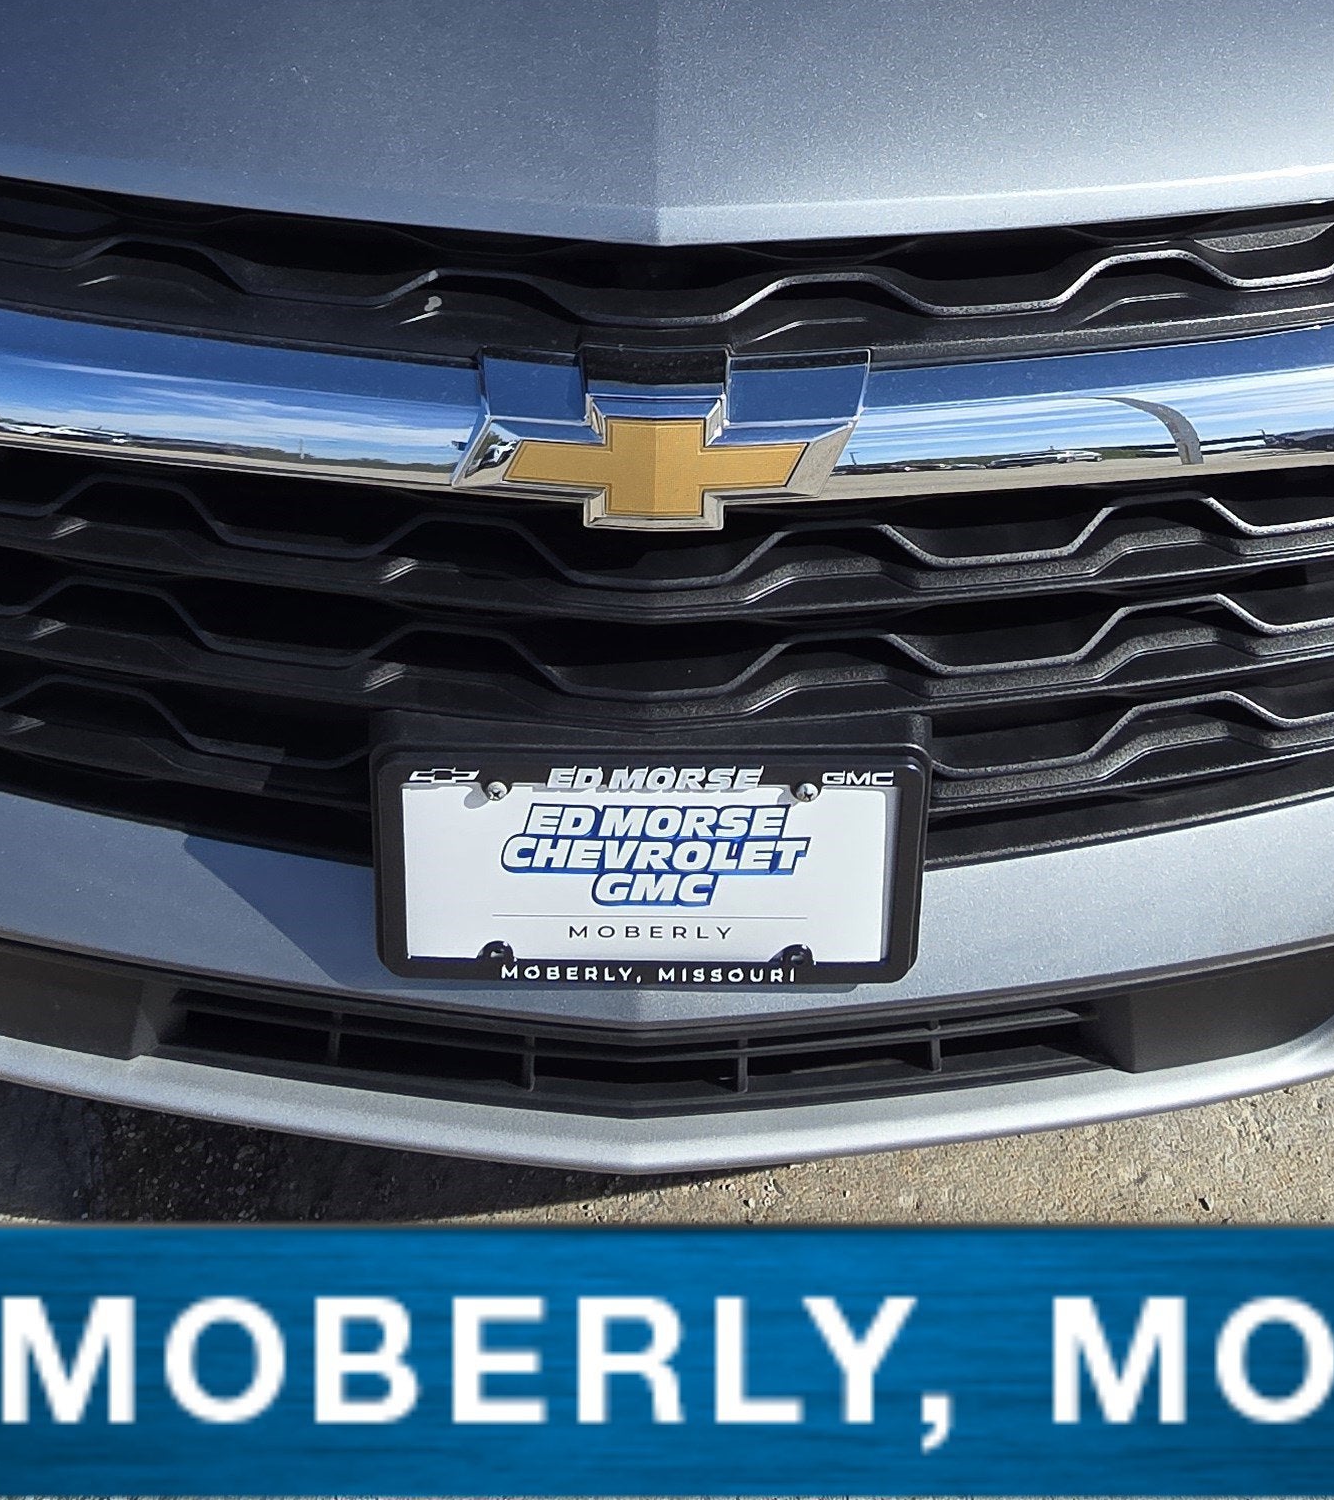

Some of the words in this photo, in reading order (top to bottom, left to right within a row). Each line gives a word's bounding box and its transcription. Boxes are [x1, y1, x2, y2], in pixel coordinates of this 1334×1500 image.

[547, 765, 604, 790] ED
[608, 765, 764, 791] MORSE
[821, 770, 894, 786] GMC
[524, 804, 597, 837] ED
[598, 804, 789, 838] MORSE
[502, 835, 808, 872] CHEVROLET
[594, 872, 716, 903] GMC
[568, 925, 732, 940] MOBERLY
[501, 964, 642, 984] MOBERLY,
[658, 967, 796, 983] MISSOURI
